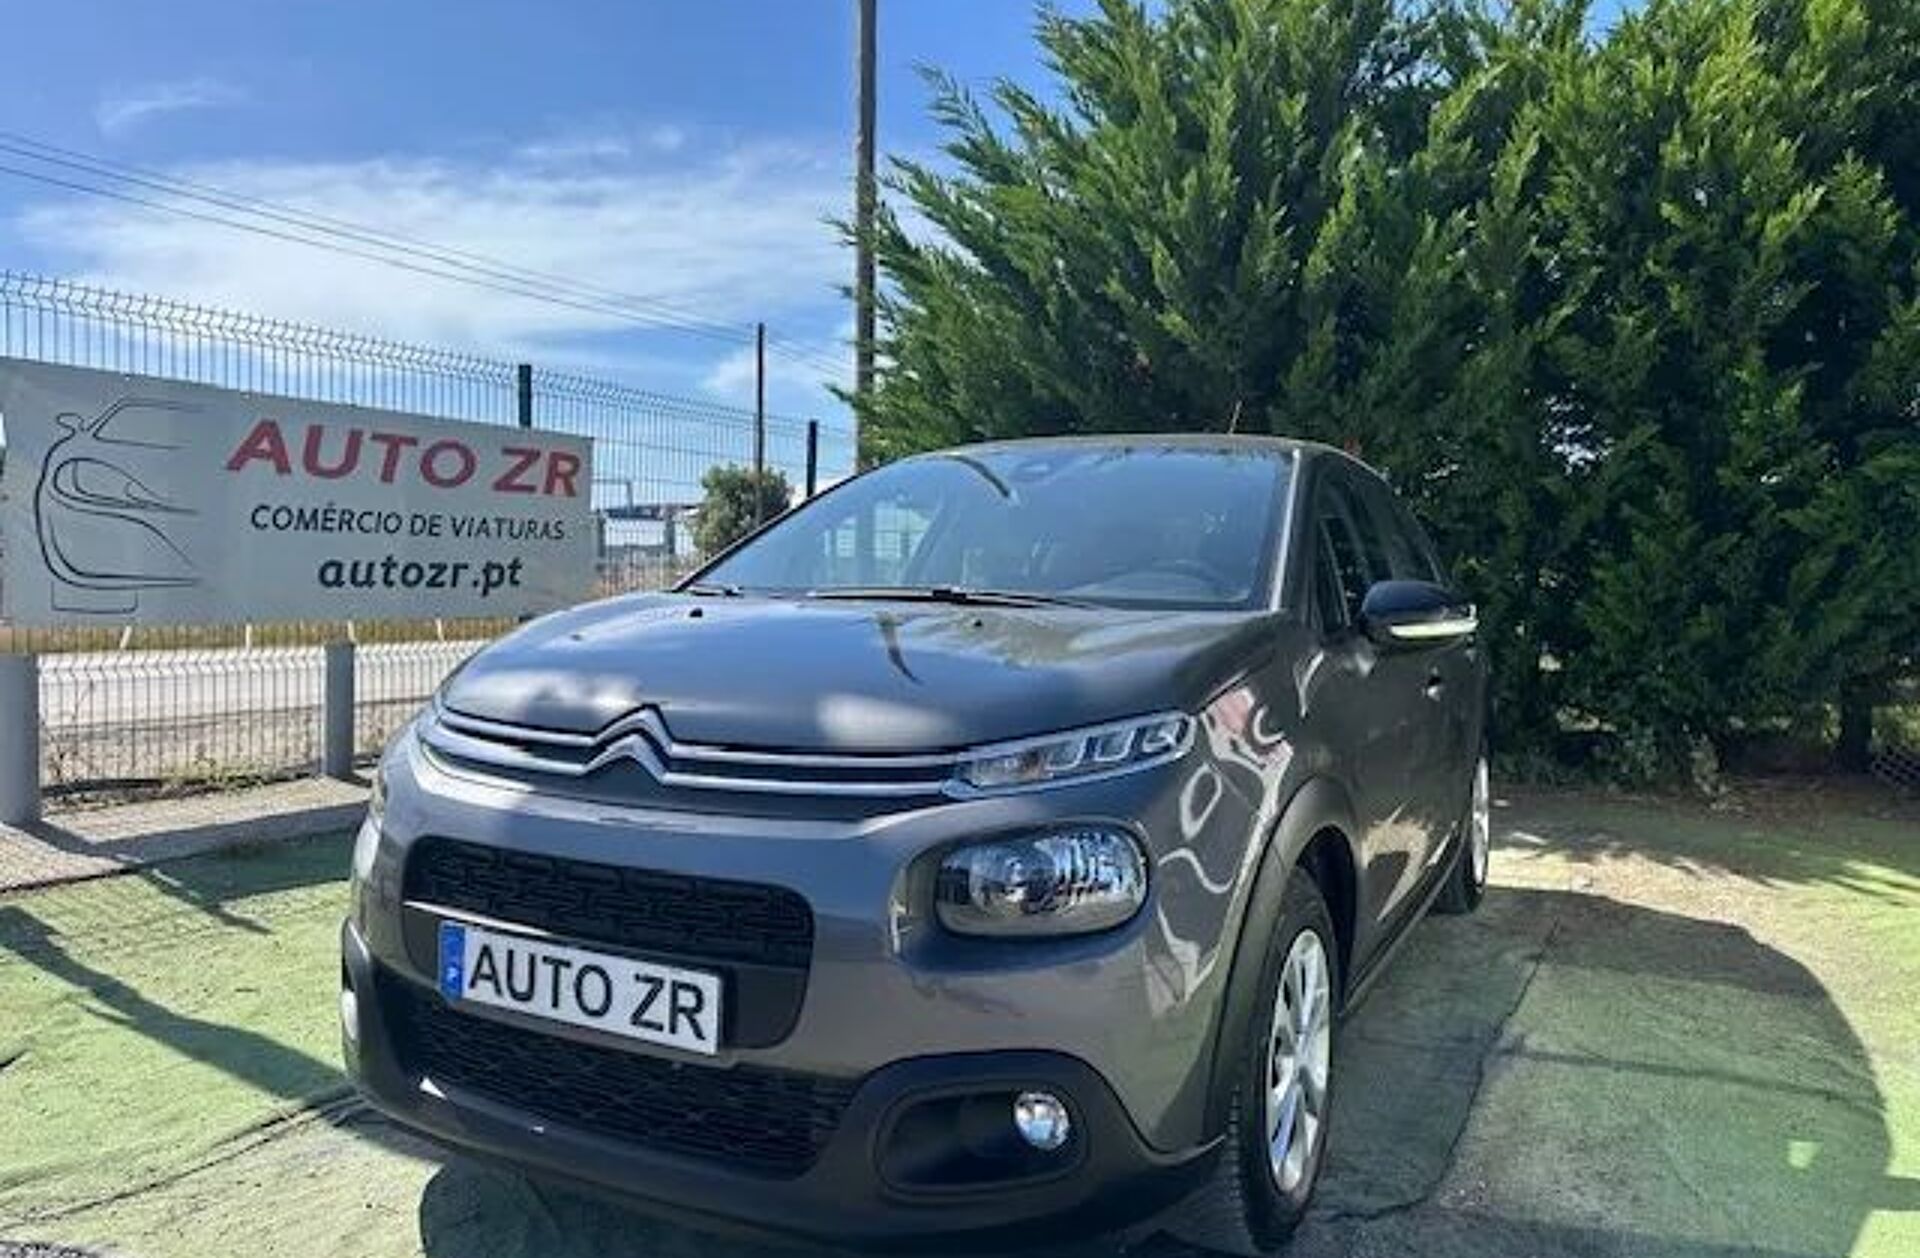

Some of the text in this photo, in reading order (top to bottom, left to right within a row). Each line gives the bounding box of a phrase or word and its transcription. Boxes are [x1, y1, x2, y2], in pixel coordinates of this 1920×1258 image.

[226, 418, 581, 498] AUTO ZR
[250, 501, 565, 540] COMÉRCIO DE VIATURAS
[318, 556, 523, 597] autozr.pt
[468, 944, 706, 1040] AUTO ZR
